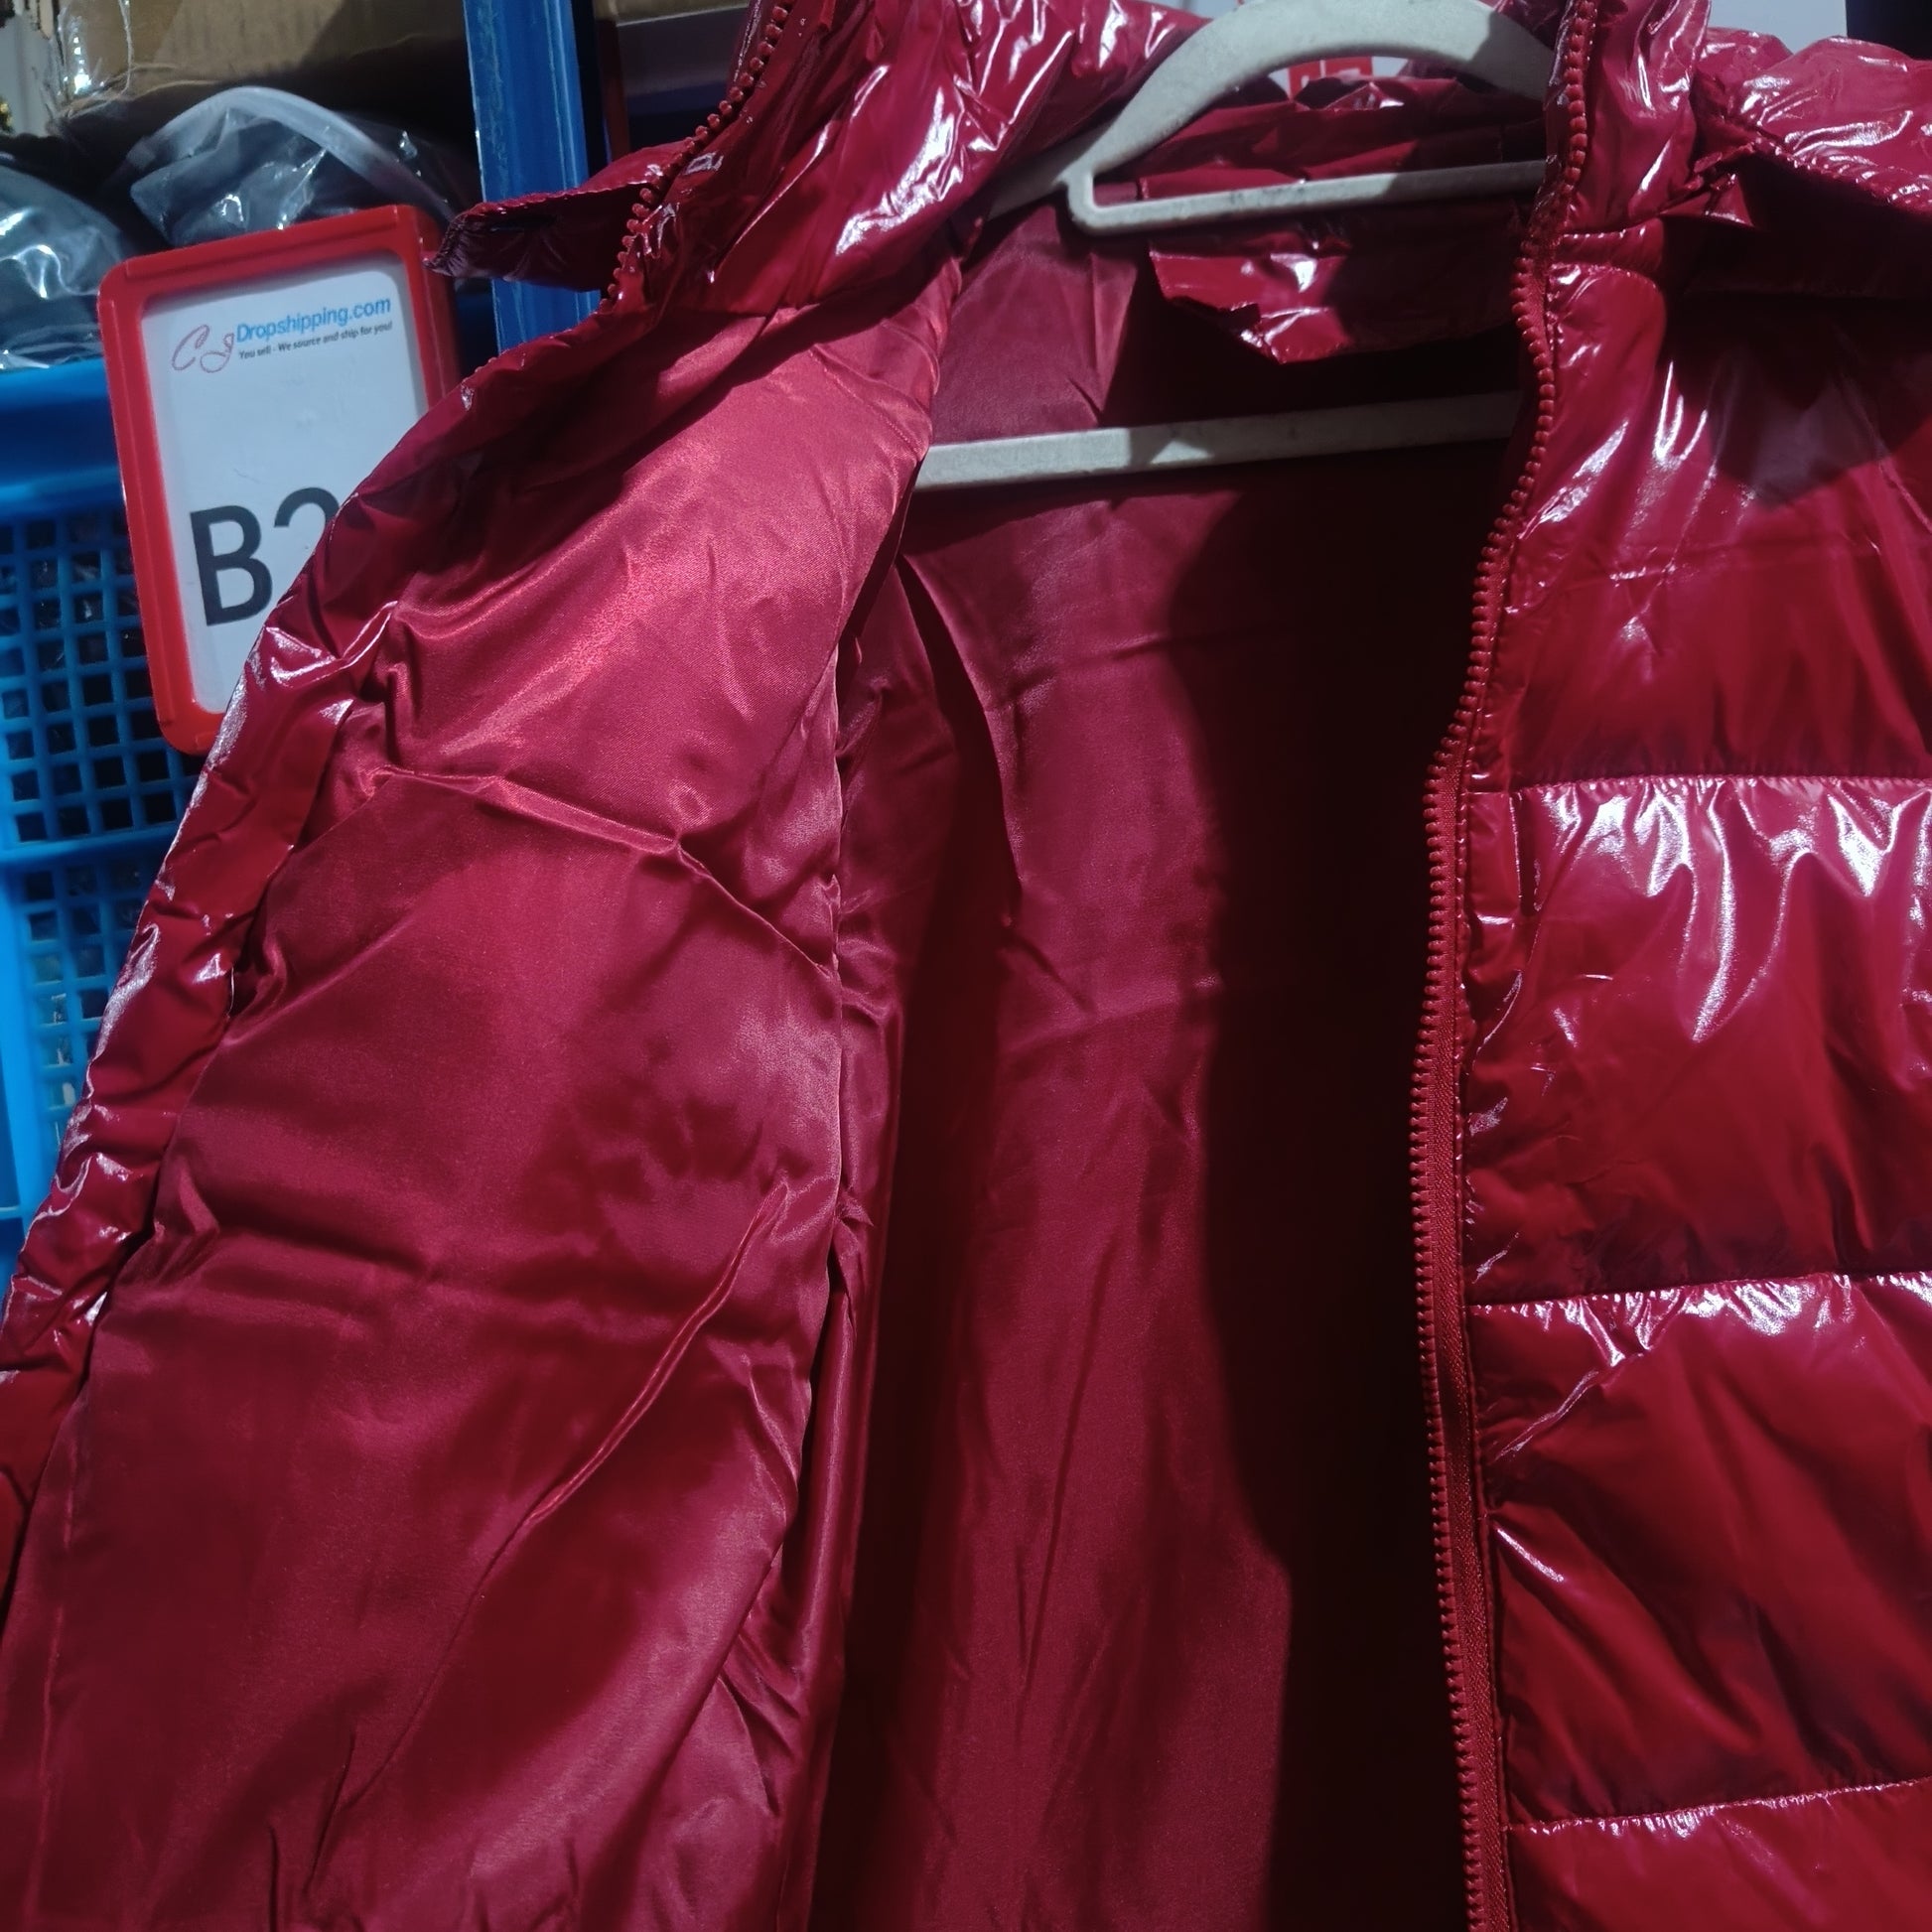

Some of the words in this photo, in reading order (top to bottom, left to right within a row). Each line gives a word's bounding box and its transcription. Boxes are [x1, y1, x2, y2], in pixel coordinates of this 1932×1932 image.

[236, 298, 391, 343] Dropshipping.com
[239, 349, 255, 359] You
[257, 345, 271, 356] sell
[278, 343, 291, 351] We
[293, 337, 321, 349] source
[323, 331, 339, 343] and
[341, 326, 358, 339] ship
[360, 325, 372, 336] for
